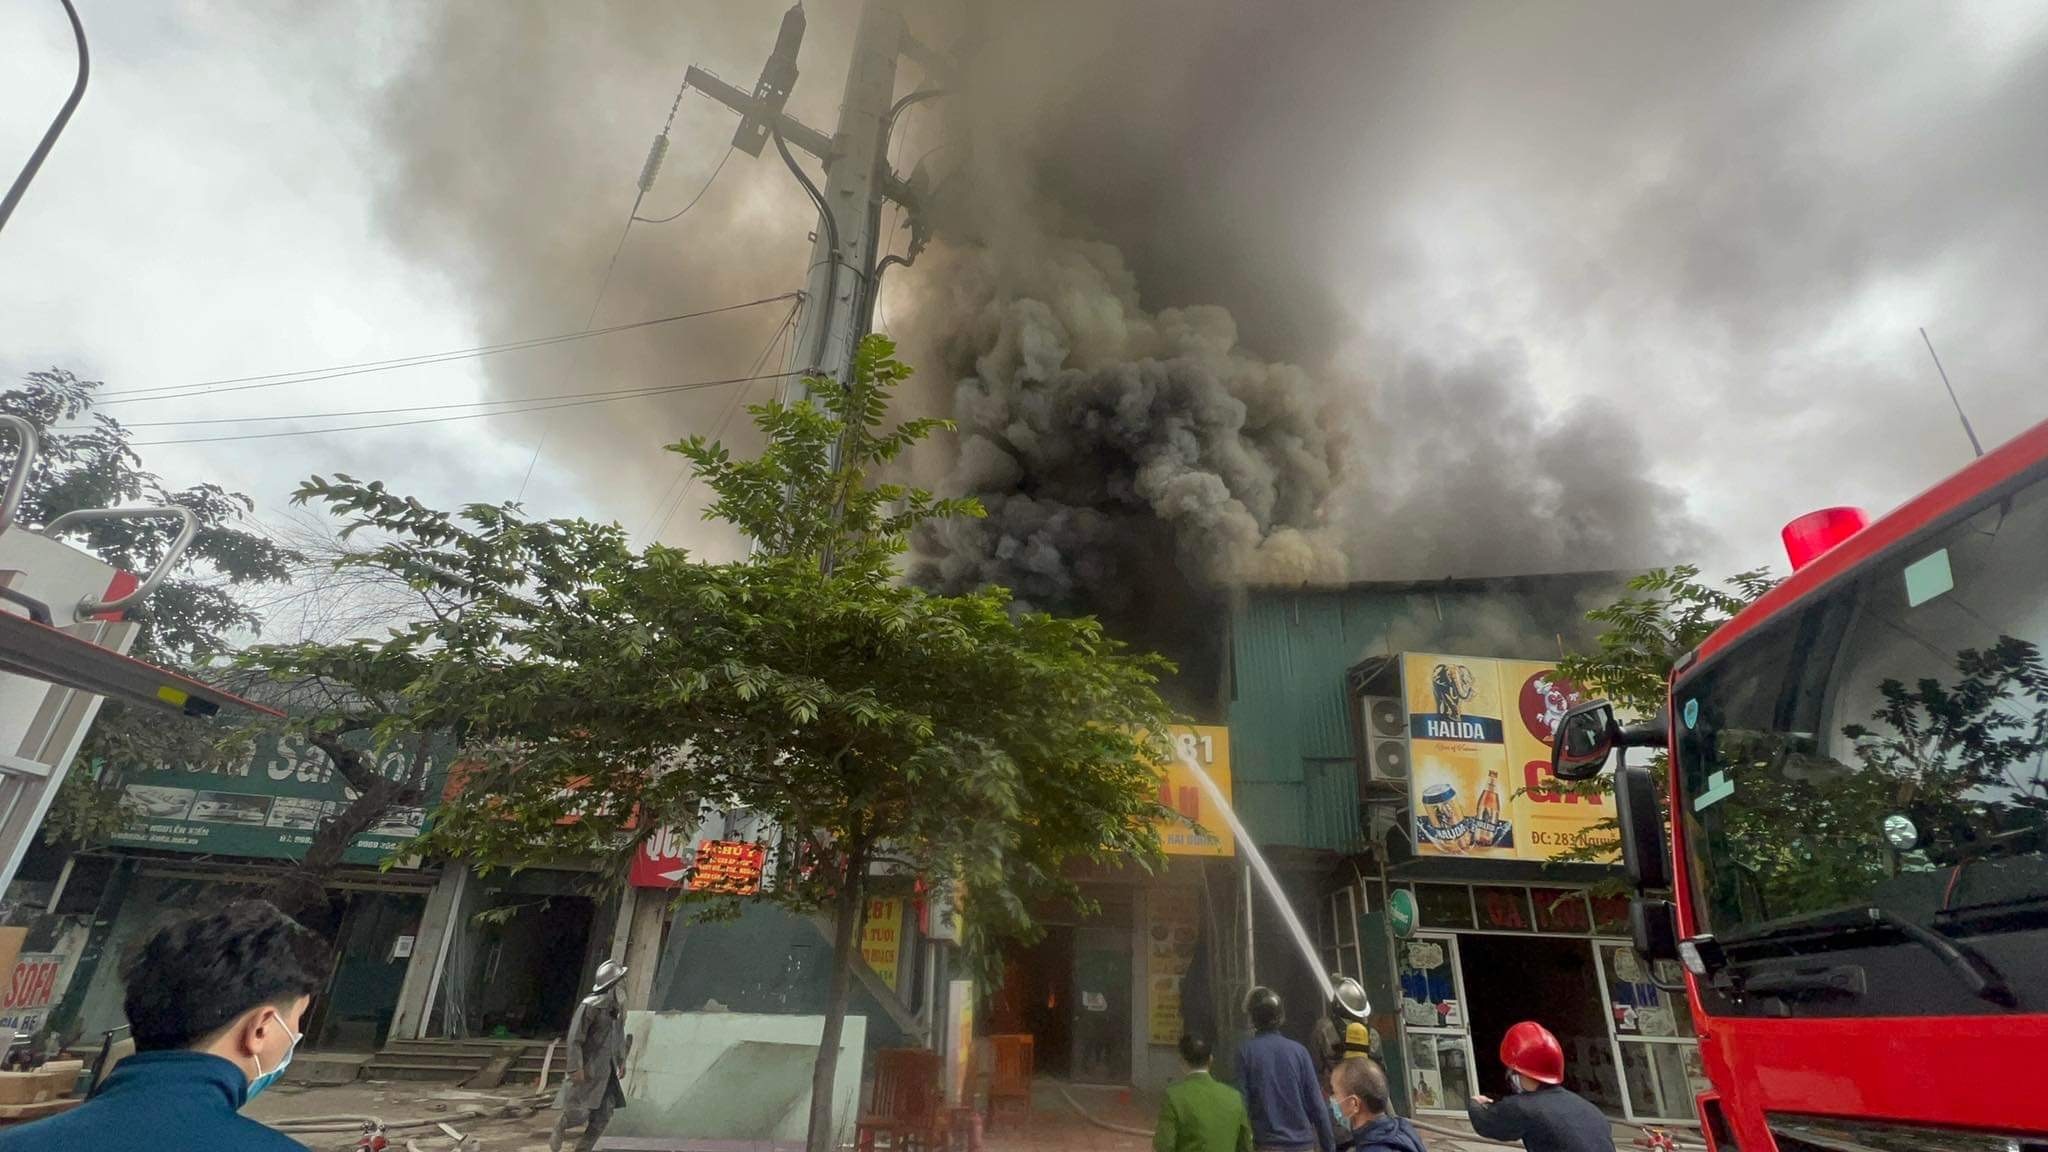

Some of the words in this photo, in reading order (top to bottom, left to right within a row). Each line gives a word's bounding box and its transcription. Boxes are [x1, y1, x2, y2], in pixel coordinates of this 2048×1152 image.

[1427, 719, 1486, 740] HALIDA
[1554, 832, 1574, 846] 283
[4, 962, 58, 1009] SOFA
